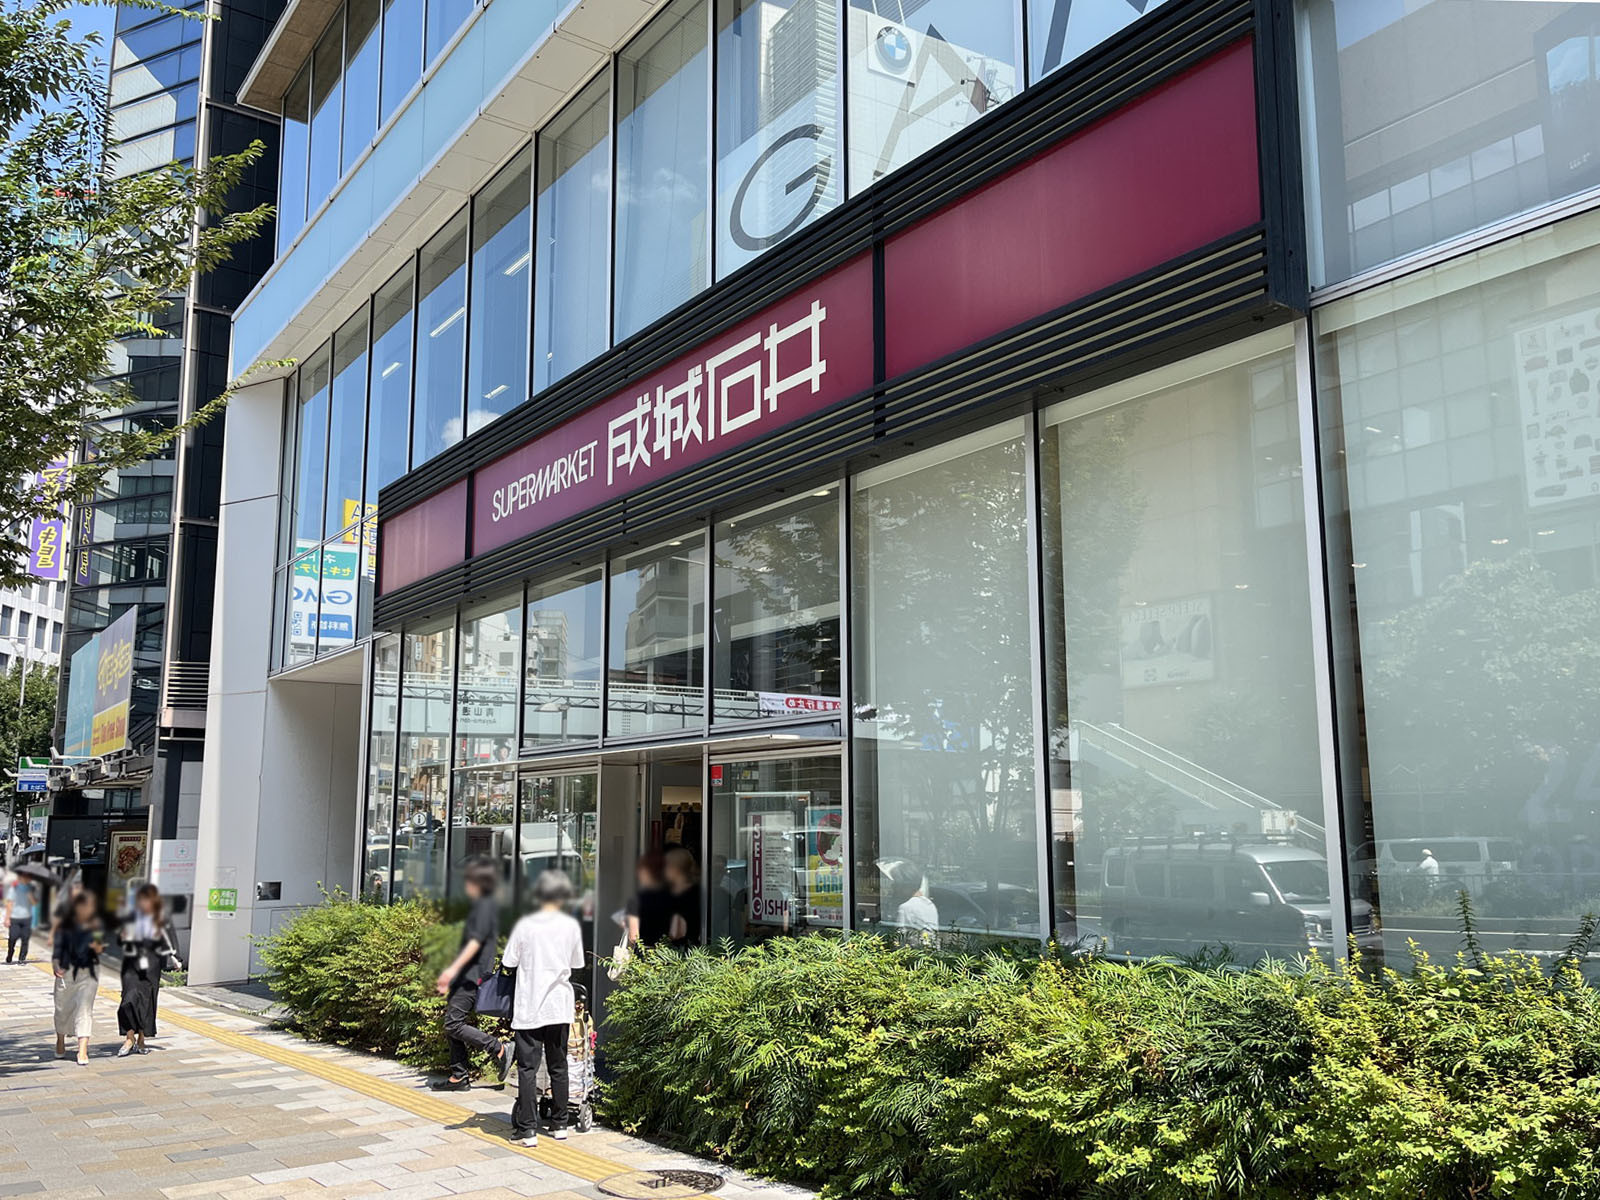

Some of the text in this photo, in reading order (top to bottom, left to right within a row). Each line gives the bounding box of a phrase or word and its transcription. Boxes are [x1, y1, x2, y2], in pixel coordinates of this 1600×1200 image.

[606, 299, 828, 486] 成城石井
[491, 440, 599, 522] SUPERMARKET
